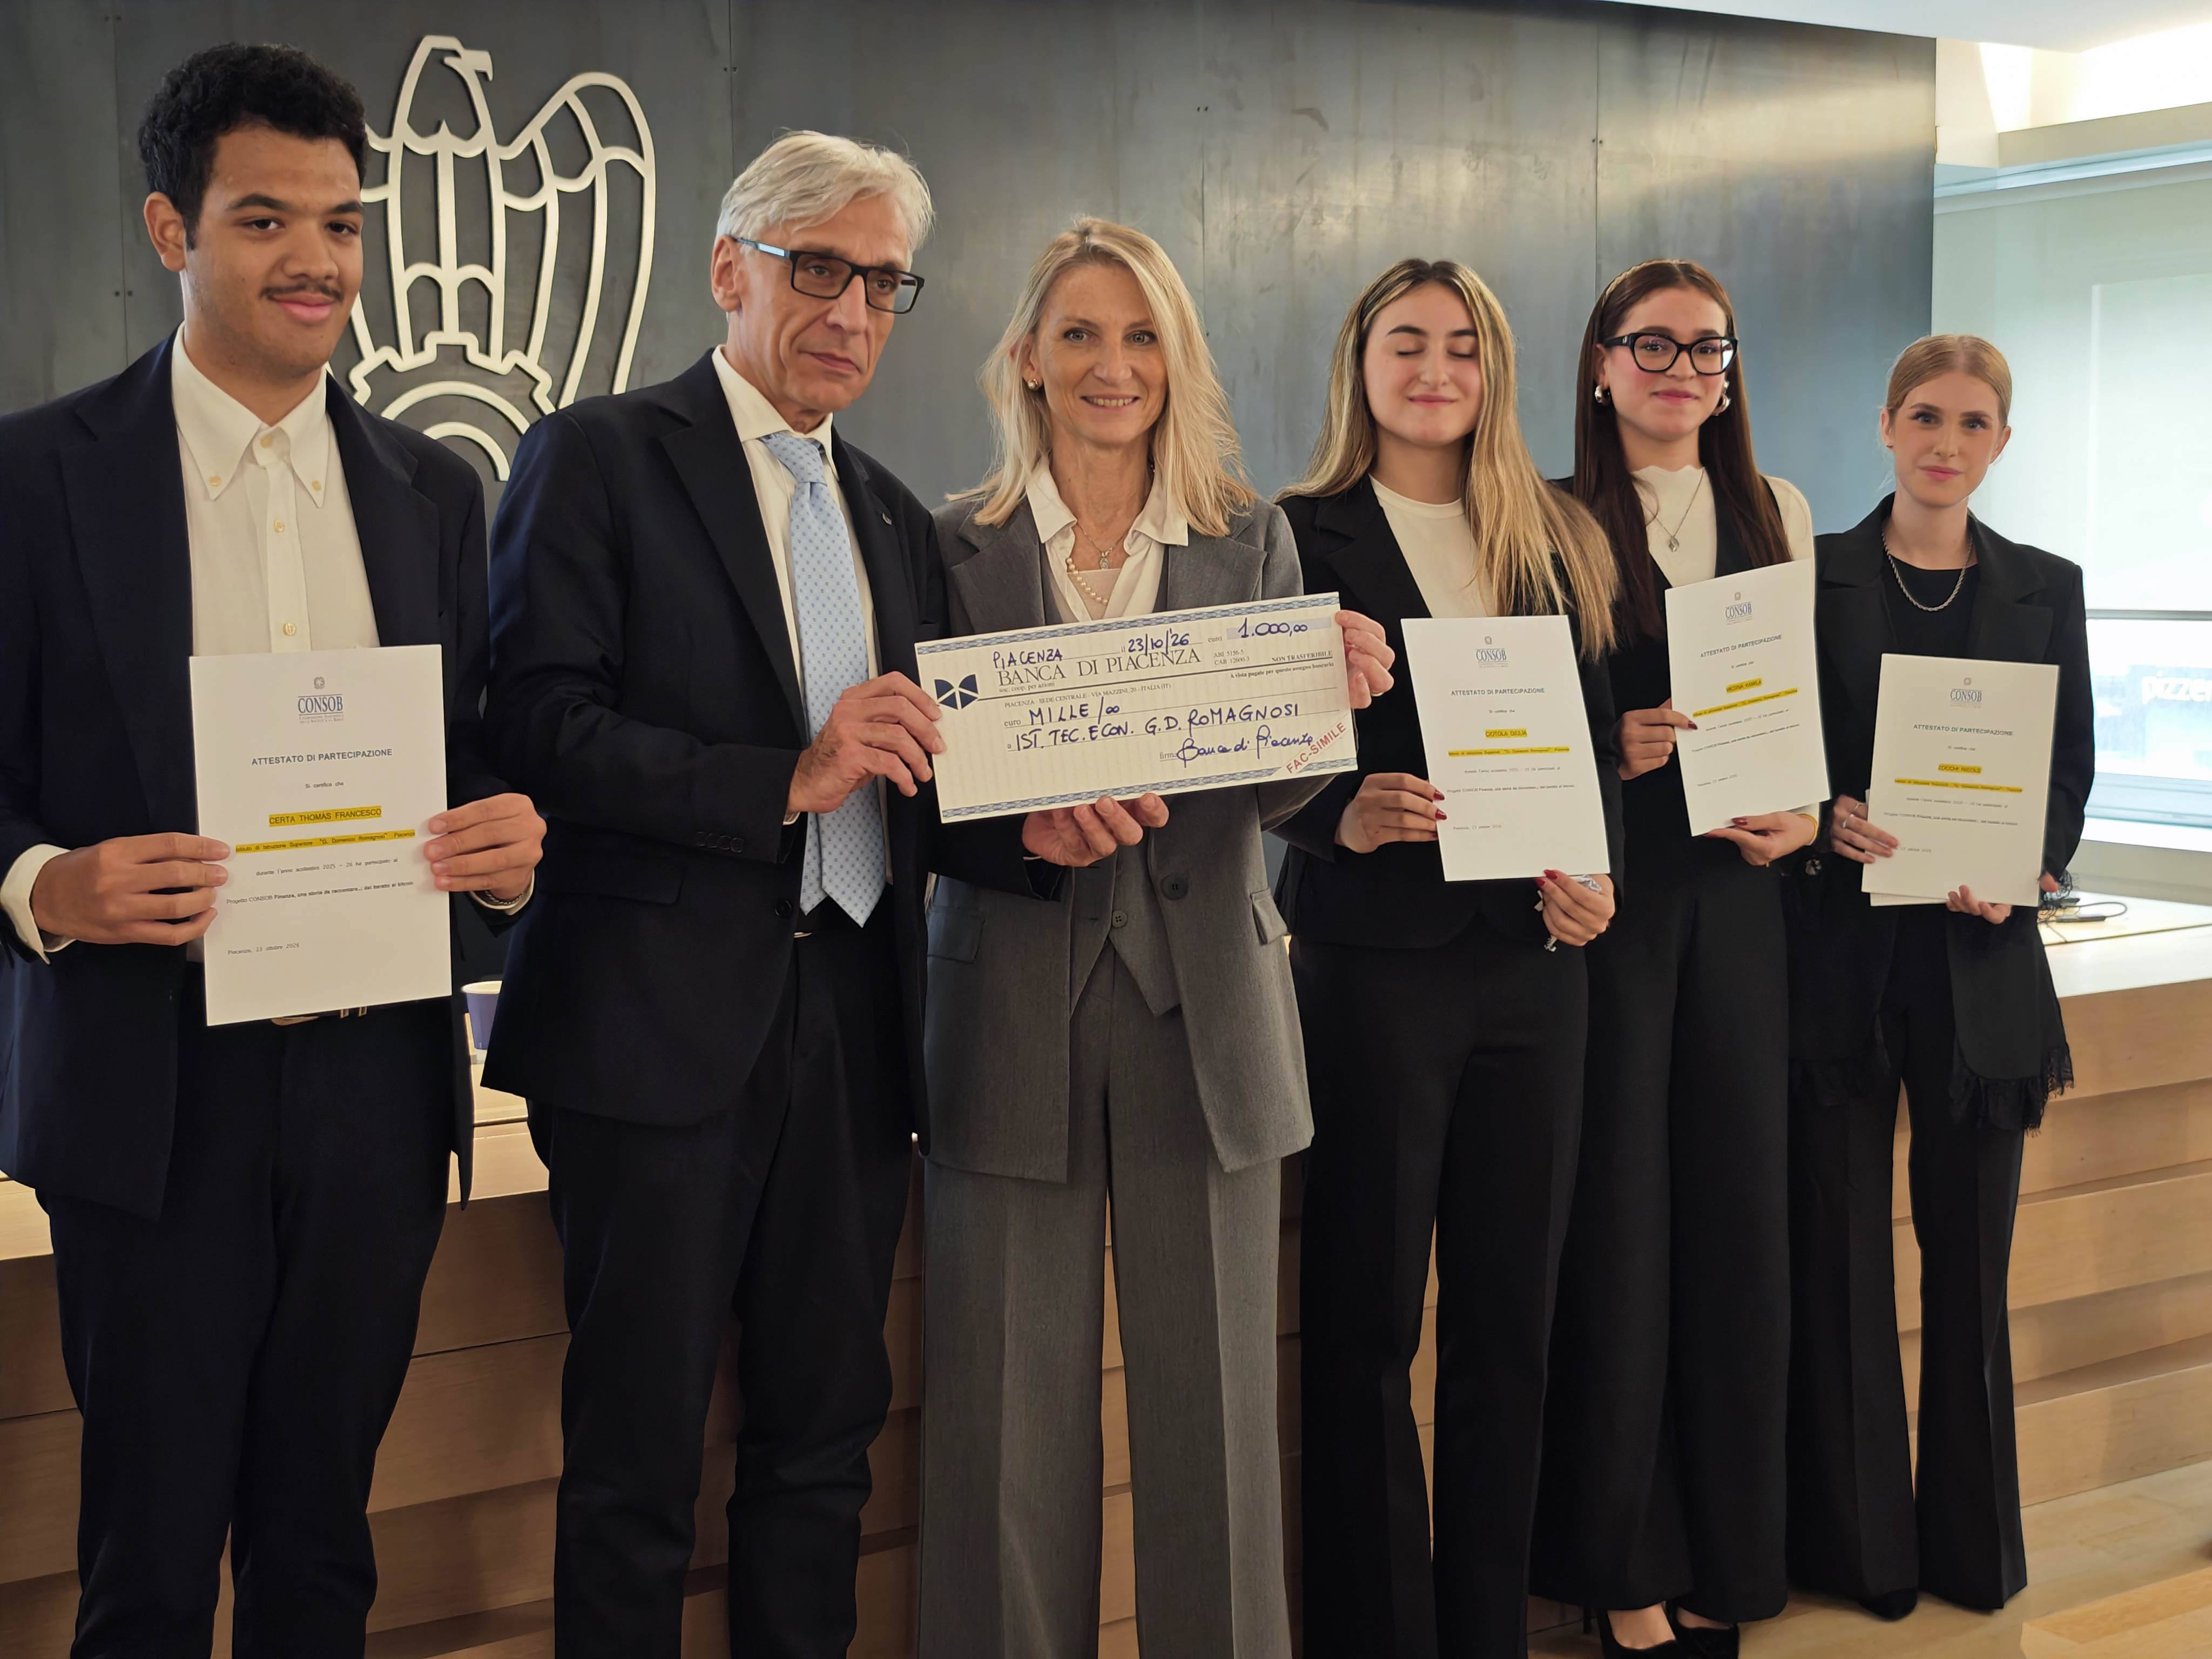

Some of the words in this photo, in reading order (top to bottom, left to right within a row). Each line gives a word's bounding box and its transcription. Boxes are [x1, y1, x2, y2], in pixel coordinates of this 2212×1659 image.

[1725, 603, 1752, 618] CONSOB
[1238, 617, 1308, 638] 1.000,00
[1701, 646, 1730, 657] ATTESTATO
[1738, 635, 1782, 649] PARTECIPAZIONE
[993, 649, 1063, 670] PIACENZA
[1287, 651, 1333, 661] TRASFERIBILE
[1476, 649, 1507, 662] CONSOB
[997, 664, 1067, 686] BANCA
[1076, 659, 1099, 677] DI
[1105, 648, 1202, 673] PIACENZA
[1004, 699, 1035, 708] PIACENZA
[1055, 693, 1087, 702] CENTRALE
[1950, 690, 1982, 702] CONSOB
[298, 696, 343, 713] CONSOB
[1029, 703, 1089, 725] MILLE
[1016, 728, 1044, 751] IST.
[1188, 703, 1298, 737] ROMAGNOSI
[1959, 727, 2013, 736] PARTECIPAZIONE
[1233, 737, 1250, 752] di
[1286, 722, 1346, 774] FAC-SIMILE
[252, 755, 304, 766] ATTESTATO
[307, 754, 315, 762] DI
[319, 748, 393, 760] PARTECIPAZIONE
[1159, 751, 1175, 759] firm
[269, 815, 295, 824] CERTA
[299, 812, 331, 821] THOMAS
[335, 808, 381, 819] FRANCESCO
